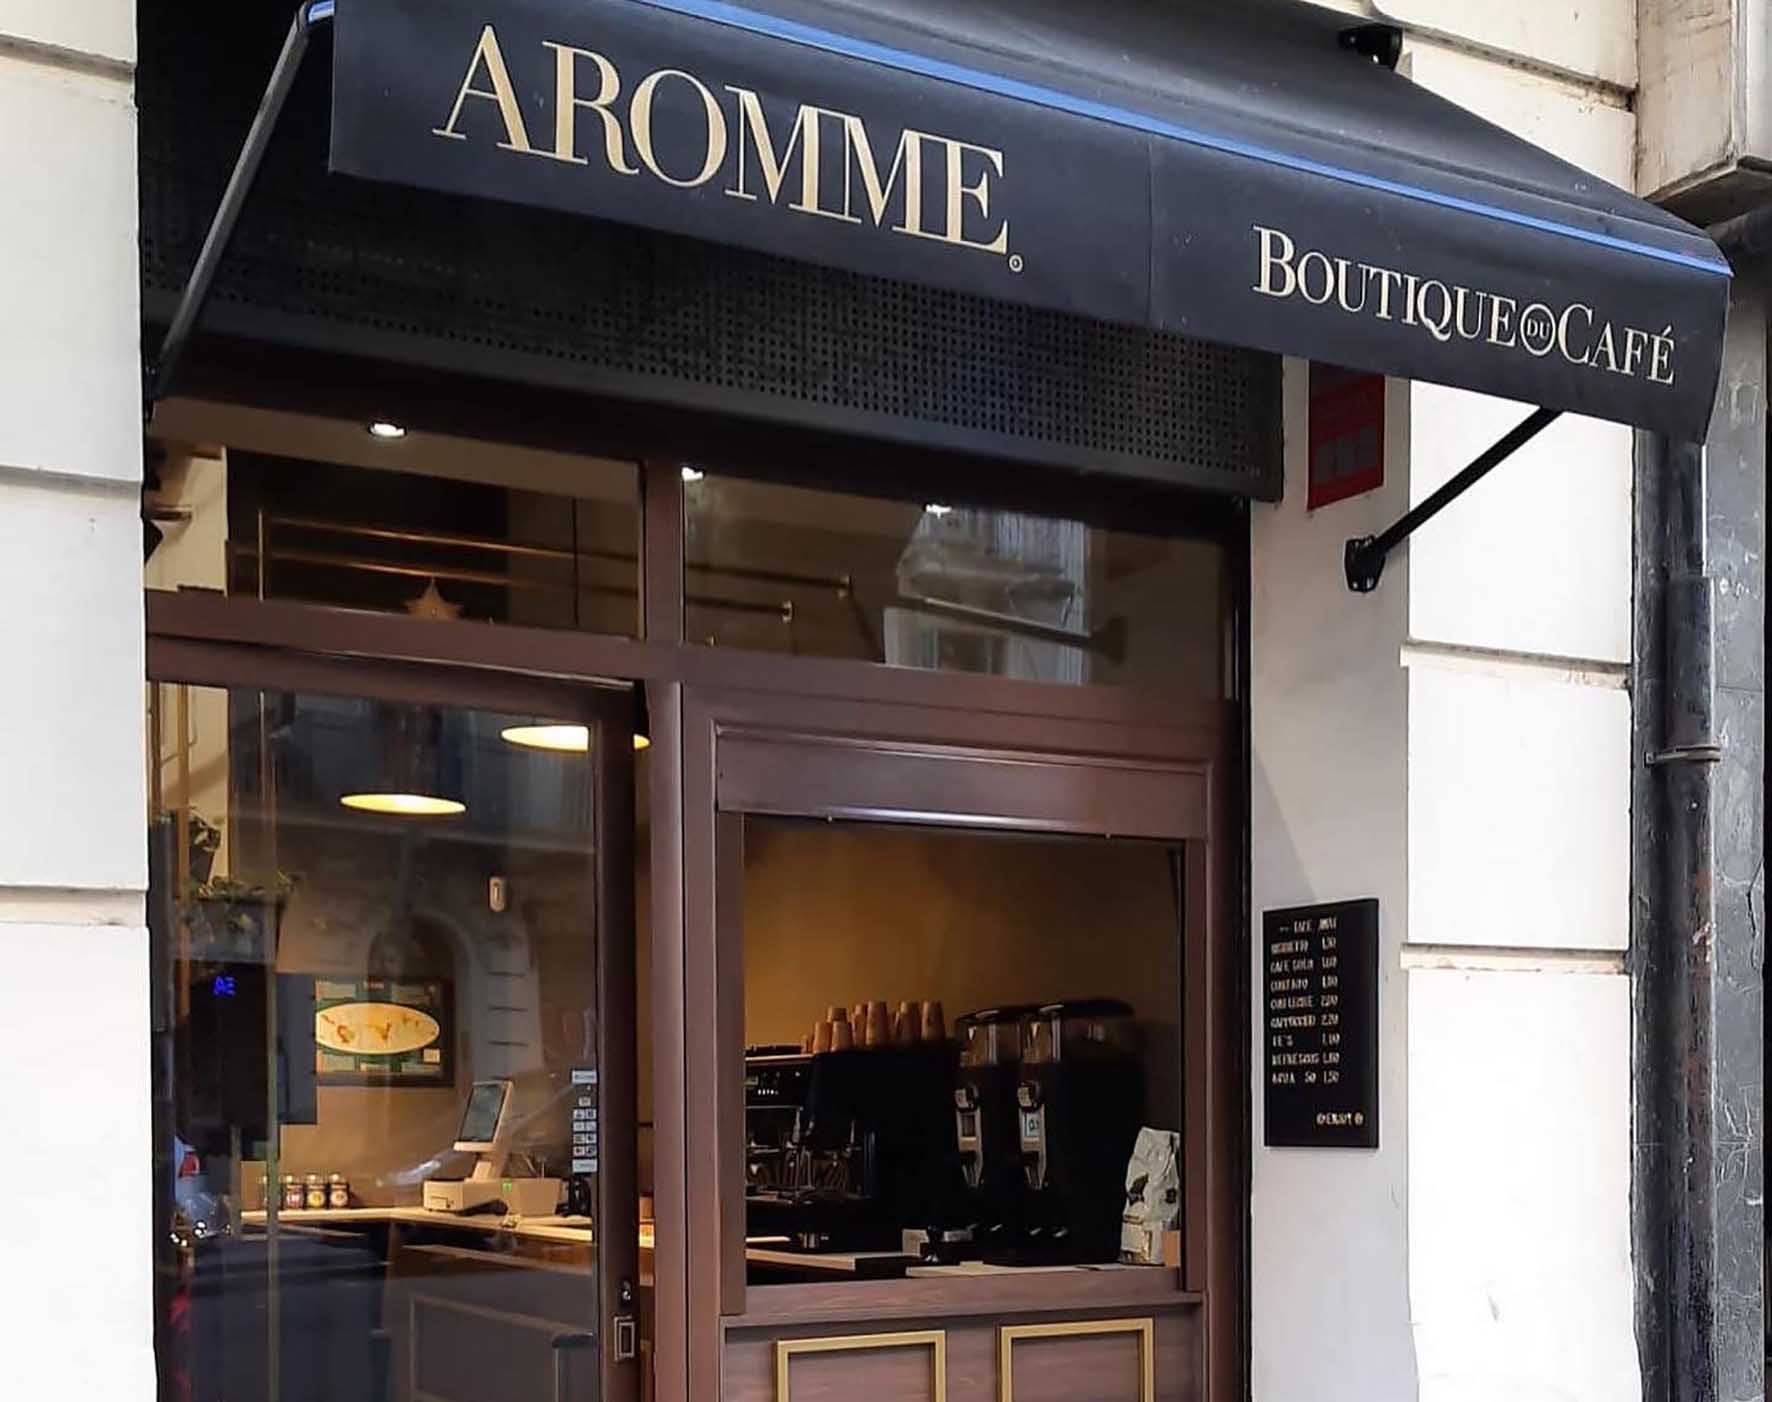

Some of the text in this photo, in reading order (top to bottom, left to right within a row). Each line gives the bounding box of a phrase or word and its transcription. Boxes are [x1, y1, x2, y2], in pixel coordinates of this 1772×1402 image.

[432, 25, 1008, 254] AROMME
[1252, 225, 1675, 385] BOUTIQUE DU CAFÉ
